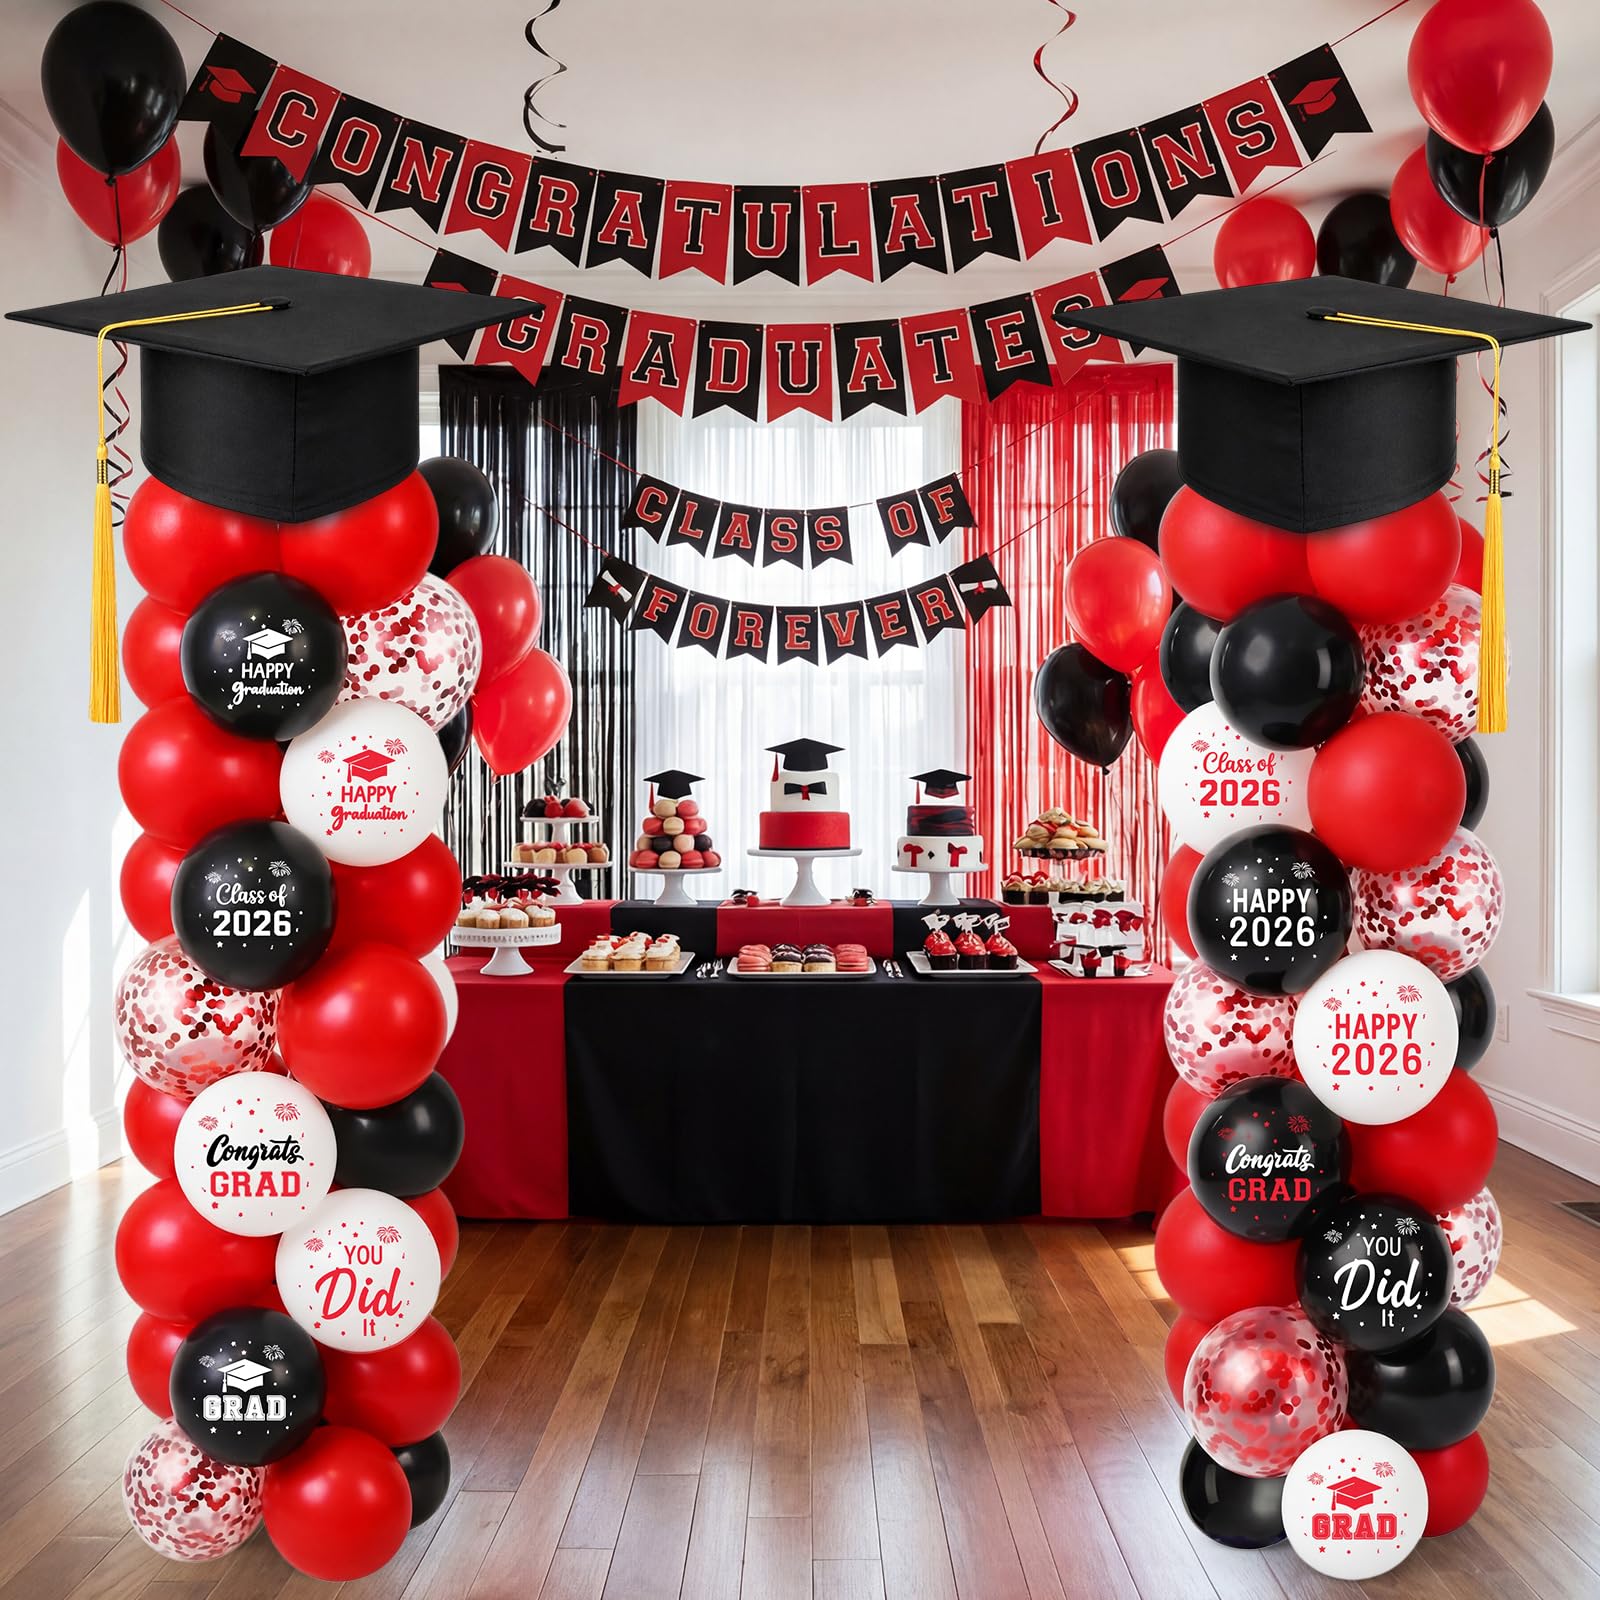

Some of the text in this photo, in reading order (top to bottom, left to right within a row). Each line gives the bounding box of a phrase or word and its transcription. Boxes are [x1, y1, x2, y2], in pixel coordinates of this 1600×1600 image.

[266, 90, 1277, 258] CONGRATULATIONS
[635, 484, 954, 553] CLASS OF
[642, 585, 954, 650] FOREVER
[241, 662, 294, 679] HAPPY
[233, 680, 304, 704] graduation
[1202, 751, 1276, 775] Class of
[341, 785, 397, 803] HAPPY
[1199, 779, 1280, 807] 2026
[332, 804, 407, 830] graduation
[215, 882, 287, 907] Class of
[1232, 888, 1312, 913] HAPPY
[213, 909, 291, 937] 2026
[1229, 916, 1316, 948] 2026
[1334, 1013, 1418, 1040] HAPPY
[1331, 1043, 1422, 1076] 2026
[206, 1134, 304, 1171] Congrats
[1225, 1143, 1316, 1177] Congrats
[209, 1171, 301, 1198] GRAD
[1228, 1177, 1312, 1203] GRAD
[344, 1245, 384, 1266] YOU
[1362, 1236, 1402, 1258] YOU
[314, 1266, 403, 1320] Did
[1333, 1258, 1422, 1312] Did
[364, 1318, 375, 1336] It
[1382, 1309, 1394, 1327] It
[202, 1395, 287, 1422] GRAD
[1311, 1513, 1398, 1541] GRAD
